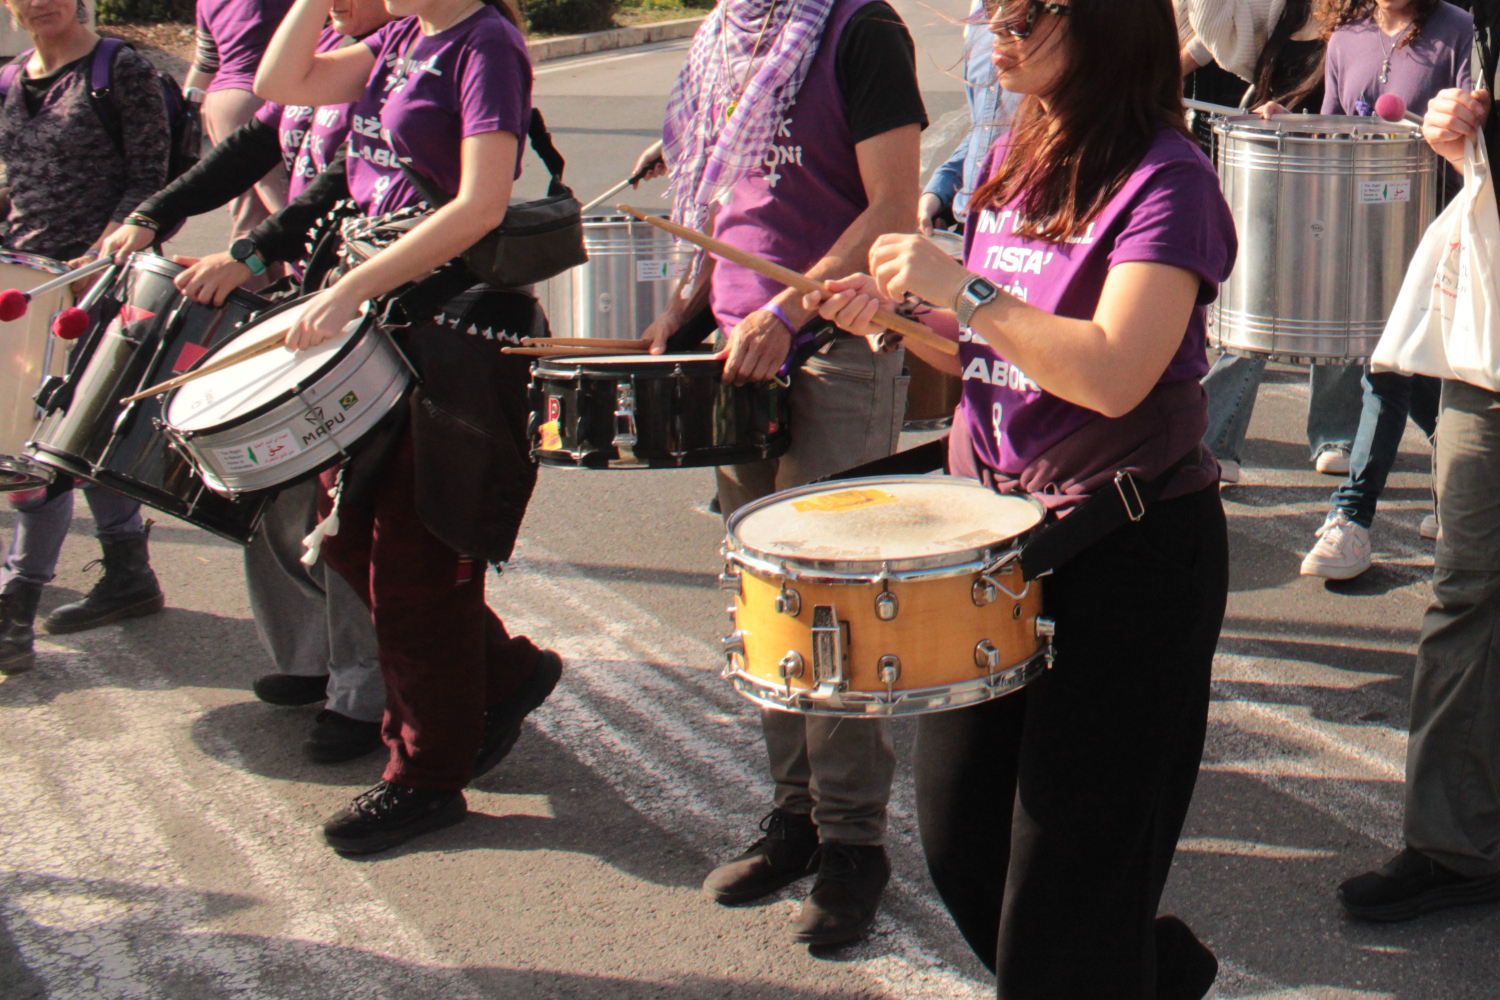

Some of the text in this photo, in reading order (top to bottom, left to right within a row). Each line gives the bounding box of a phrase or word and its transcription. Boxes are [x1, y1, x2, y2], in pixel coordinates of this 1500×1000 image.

[976, 209, 1012, 235] INT
[984, 245, 1054, 275] TISTA'
[302, 412, 345, 446] MAPU
